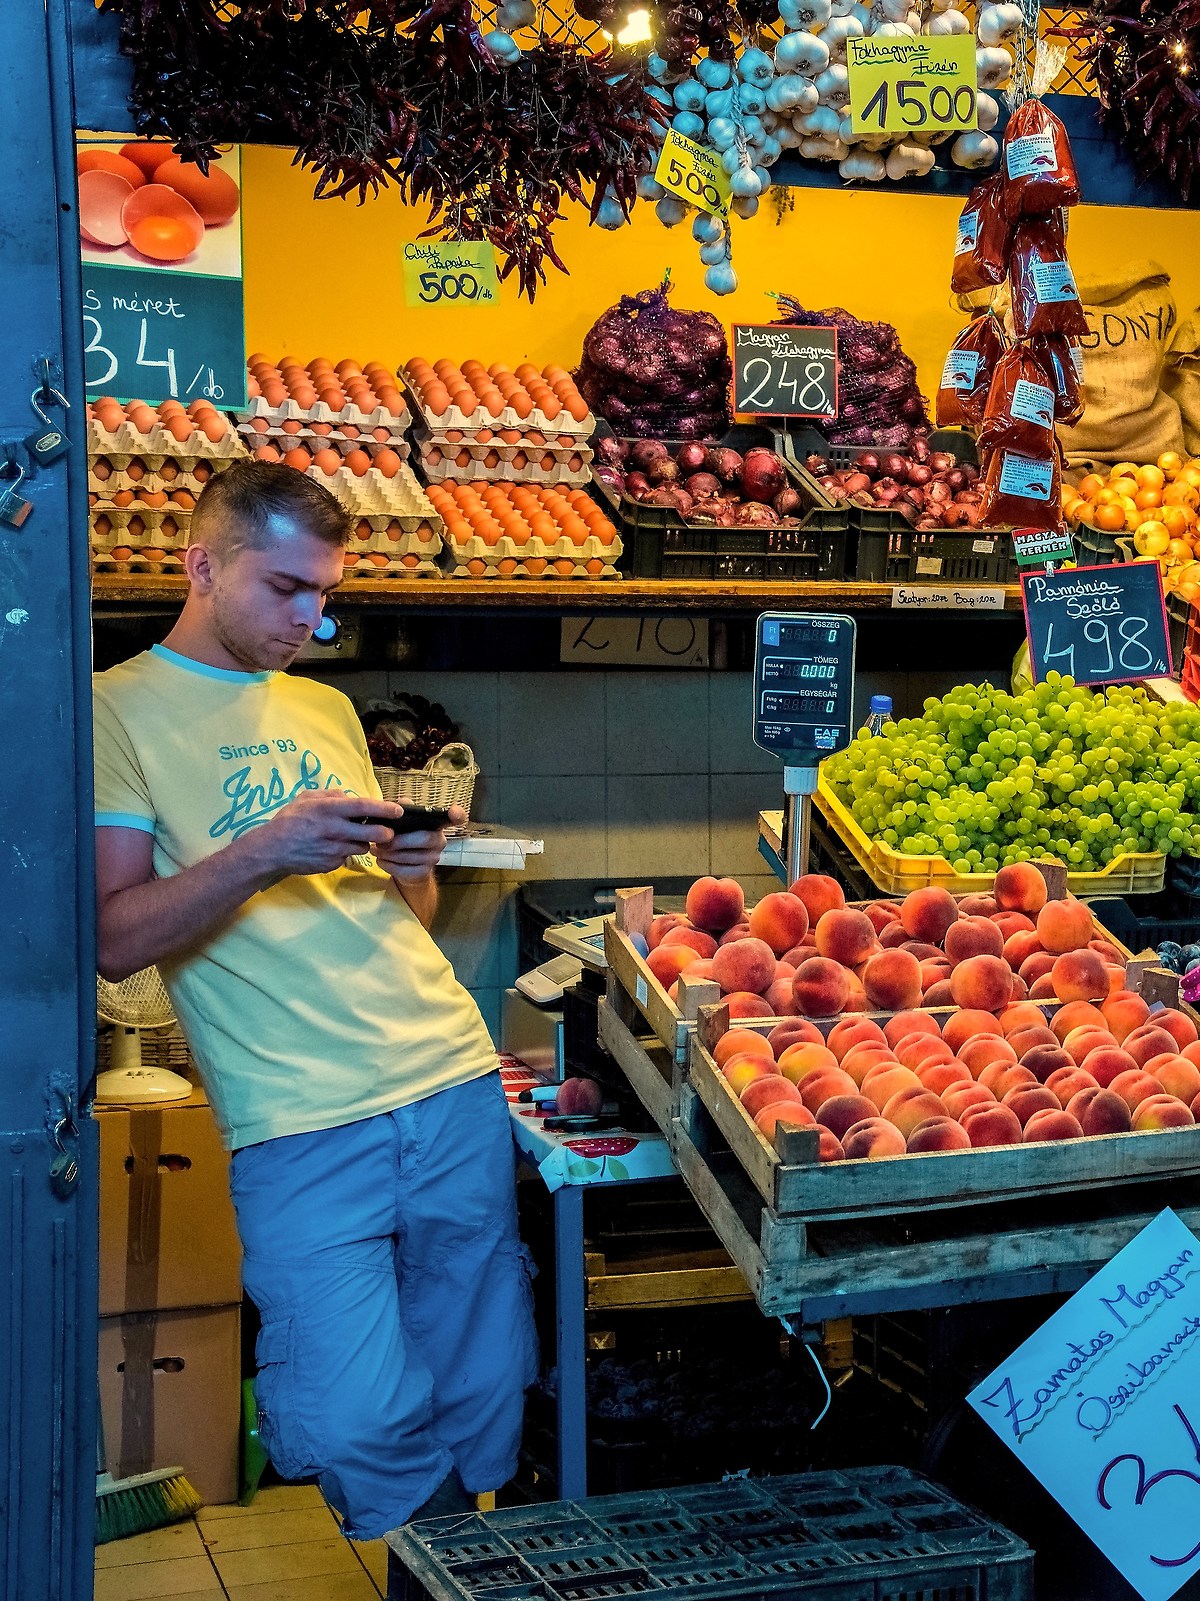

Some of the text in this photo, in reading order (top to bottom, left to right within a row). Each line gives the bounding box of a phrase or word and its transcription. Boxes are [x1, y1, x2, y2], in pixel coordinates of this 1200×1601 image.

[849, 38, 931, 63] Fokhagyma
[861, 80, 975, 129] 1500
[427, 256, 485, 271] Paprika
[112, 292, 185, 319] méret
[737, 327, 790, 347] Magyar
[1020, 541, 1067, 556] TERMÉK
[1028, 576, 1120, 602] Pannónia
[811, 620, 840, 629] ÖSSZEG
[813, 655, 839, 665] TÖMEG
[800, 689, 838, 699] EGYSÉGÁR
[829, 681, 838, 690] kg
[814, 728, 840, 737] CAS
[219, 739, 298, 761] Since '93
[980, 1249, 1194, 1436] Zamatos Magyar
